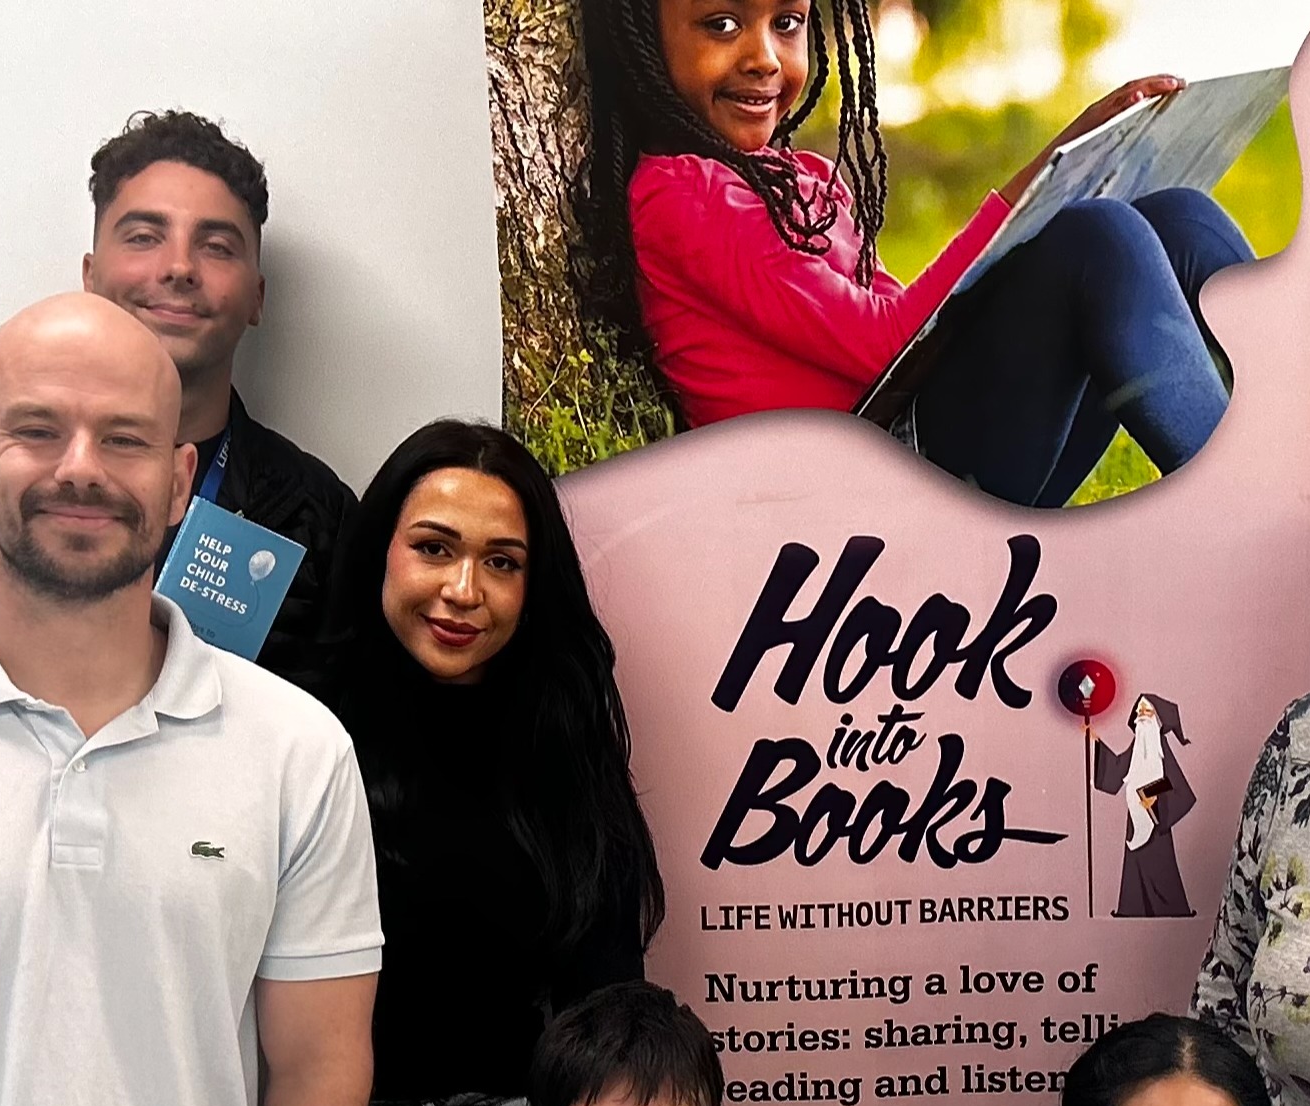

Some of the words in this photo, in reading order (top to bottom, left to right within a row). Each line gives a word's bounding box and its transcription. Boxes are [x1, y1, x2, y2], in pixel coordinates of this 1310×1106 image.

[193, 547, 229, 573] YOUR
[199, 533, 232, 555] HELP
[186, 563, 226, 587] CHILD
[180, 576, 247, 615] DE-STRESS
[710, 534, 1058, 712] Hook
[827, 704, 927, 771] into
[699, 734, 1069, 871] Books
[701, 905, 772, 931] LIFE
[778, 900, 912, 930] WITHOUT
[919, 895, 1070, 923] BARRIERS
[705, 970, 913, 1003] Nurturing
[924, 974, 948, 995] a
[960, 964, 1045, 994] love
[1057, 963, 1099, 993] of
[711, 1022, 852, 1053] stories:
[864, 1015, 1029, 1051] sharing,
[1041, 1013, 1120, 1043] telli
[723, 1072, 863, 1106] eading
[875, 1066, 948, 1098] and
